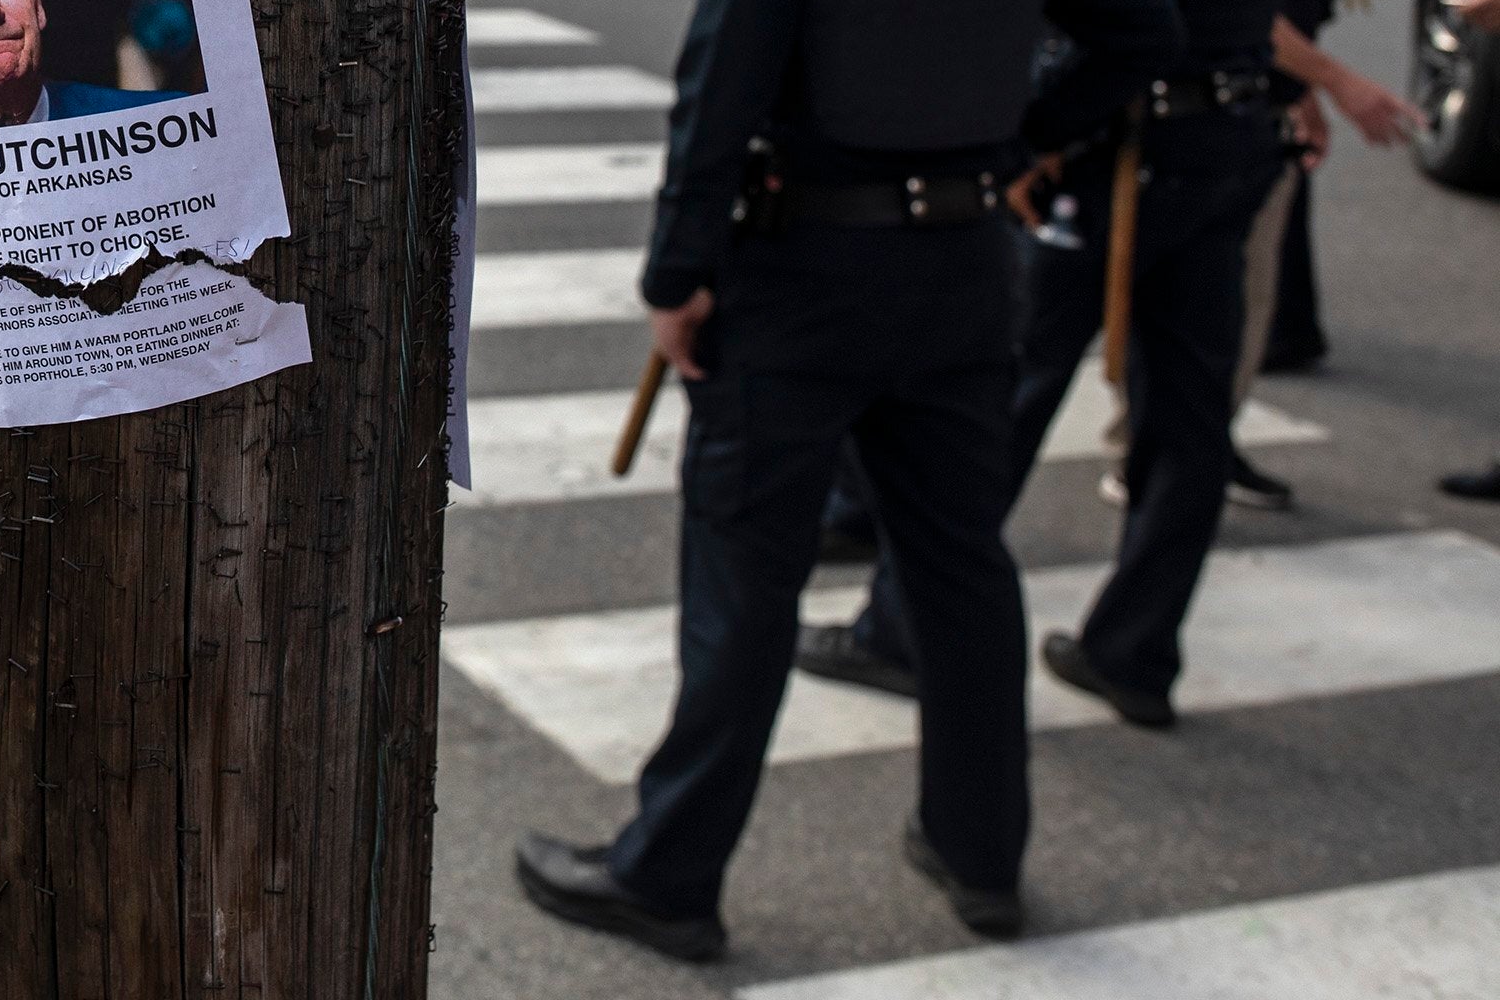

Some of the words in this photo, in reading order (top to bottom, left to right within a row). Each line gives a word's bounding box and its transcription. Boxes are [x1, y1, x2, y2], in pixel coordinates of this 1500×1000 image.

[26, 165, 133, 195] ARKANSAS
[81, 215, 107, 233] OF
[114, 193, 216, 229] ABORTION
[8, 245, 62, 265] RIGHT
[67, 241, 94, 259] TO
[100, 225, 190, 255] CHOOSE.
[10, 306, 25, 317] OF
[28, 302, 51, 315] SHIT
[56, 300, 67, 311] IS
[69, 300, 81, 309] IN
[140, 285, 165, 298] FOR
[167, 278, 191, 293] THE
[38, 311, 103, 327] ASSOCIAT
[117, 298, 169, 316] MEETING
[172, 290, 198, 305] THIS
[200, 280, 236, 297] WEEK.
[3, 361, 23, 371] HIM
[25, 356, 73, 370] AROUND
[77, 349, 113, 362] TOWN,
[115, 345, 134, 357] OR
[137, 336, 179, 353] EATING
[181, 325, 223, 344] DINNER
[225, 318, 240, 332] AT:
[4, 347, 20, 358] TO
[22, 344, 47, 356] GIVE
[51, 341, 73, 353] HIM
[74, 339, 83, 350] A
[84, 333, 121, 348] WARM
[123, 320, 187, 343] PORTLAND
[189, 302, 245, 329] WELCOME
[5, 373, 21, 384] OR
[24, 365, 88, 383] PORTHOLE,
[90, 360, 114, 375] 5:30
[116, 359, 137, 372] PM,
[139, 341, 211, 366] WEDNESDAY
